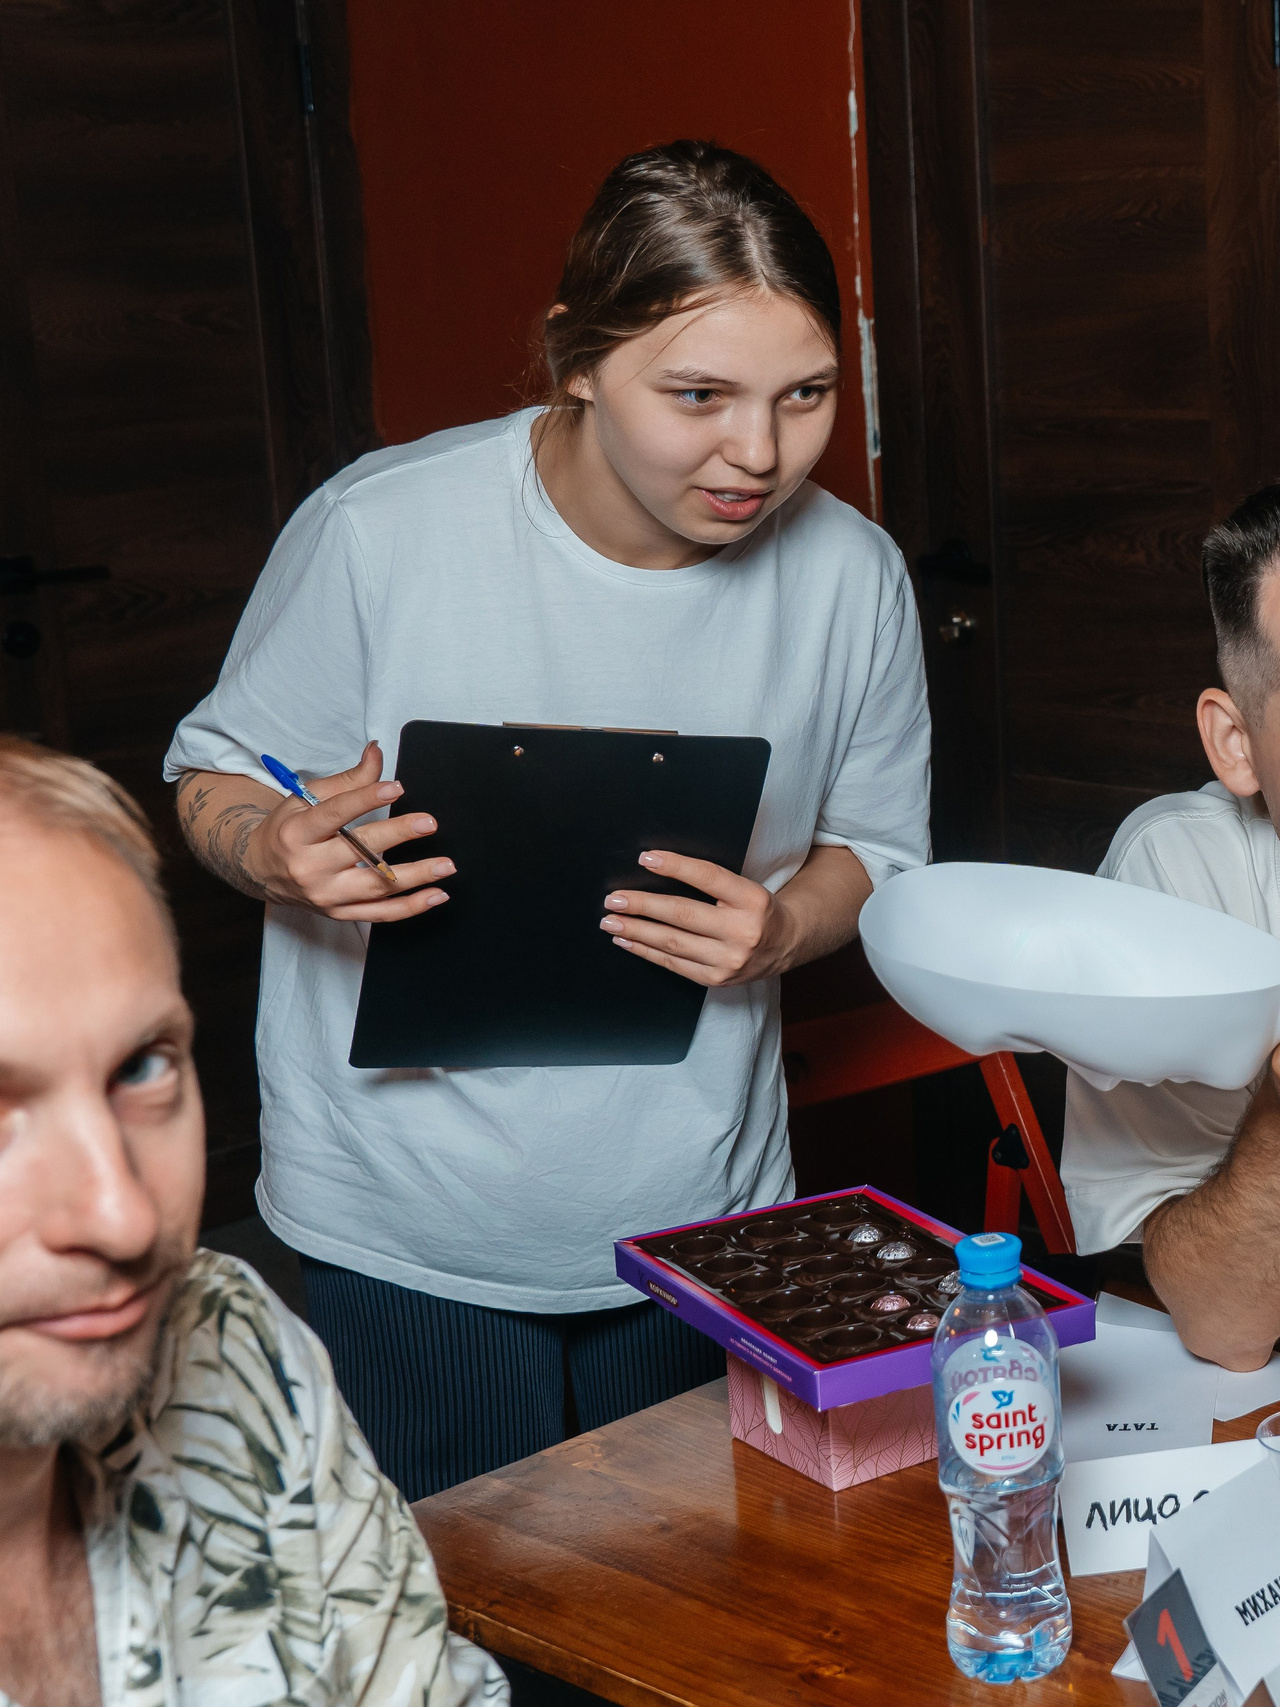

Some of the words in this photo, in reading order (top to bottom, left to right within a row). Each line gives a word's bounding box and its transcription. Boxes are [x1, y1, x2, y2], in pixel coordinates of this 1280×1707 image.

[972, 1403, 1037, 1430] saint
[964, 1424, 1045, 1456] spring
[1085, 1492, 1181, 1531] ЛИЦО
[1157, 1608, 1194, 1682] 1
